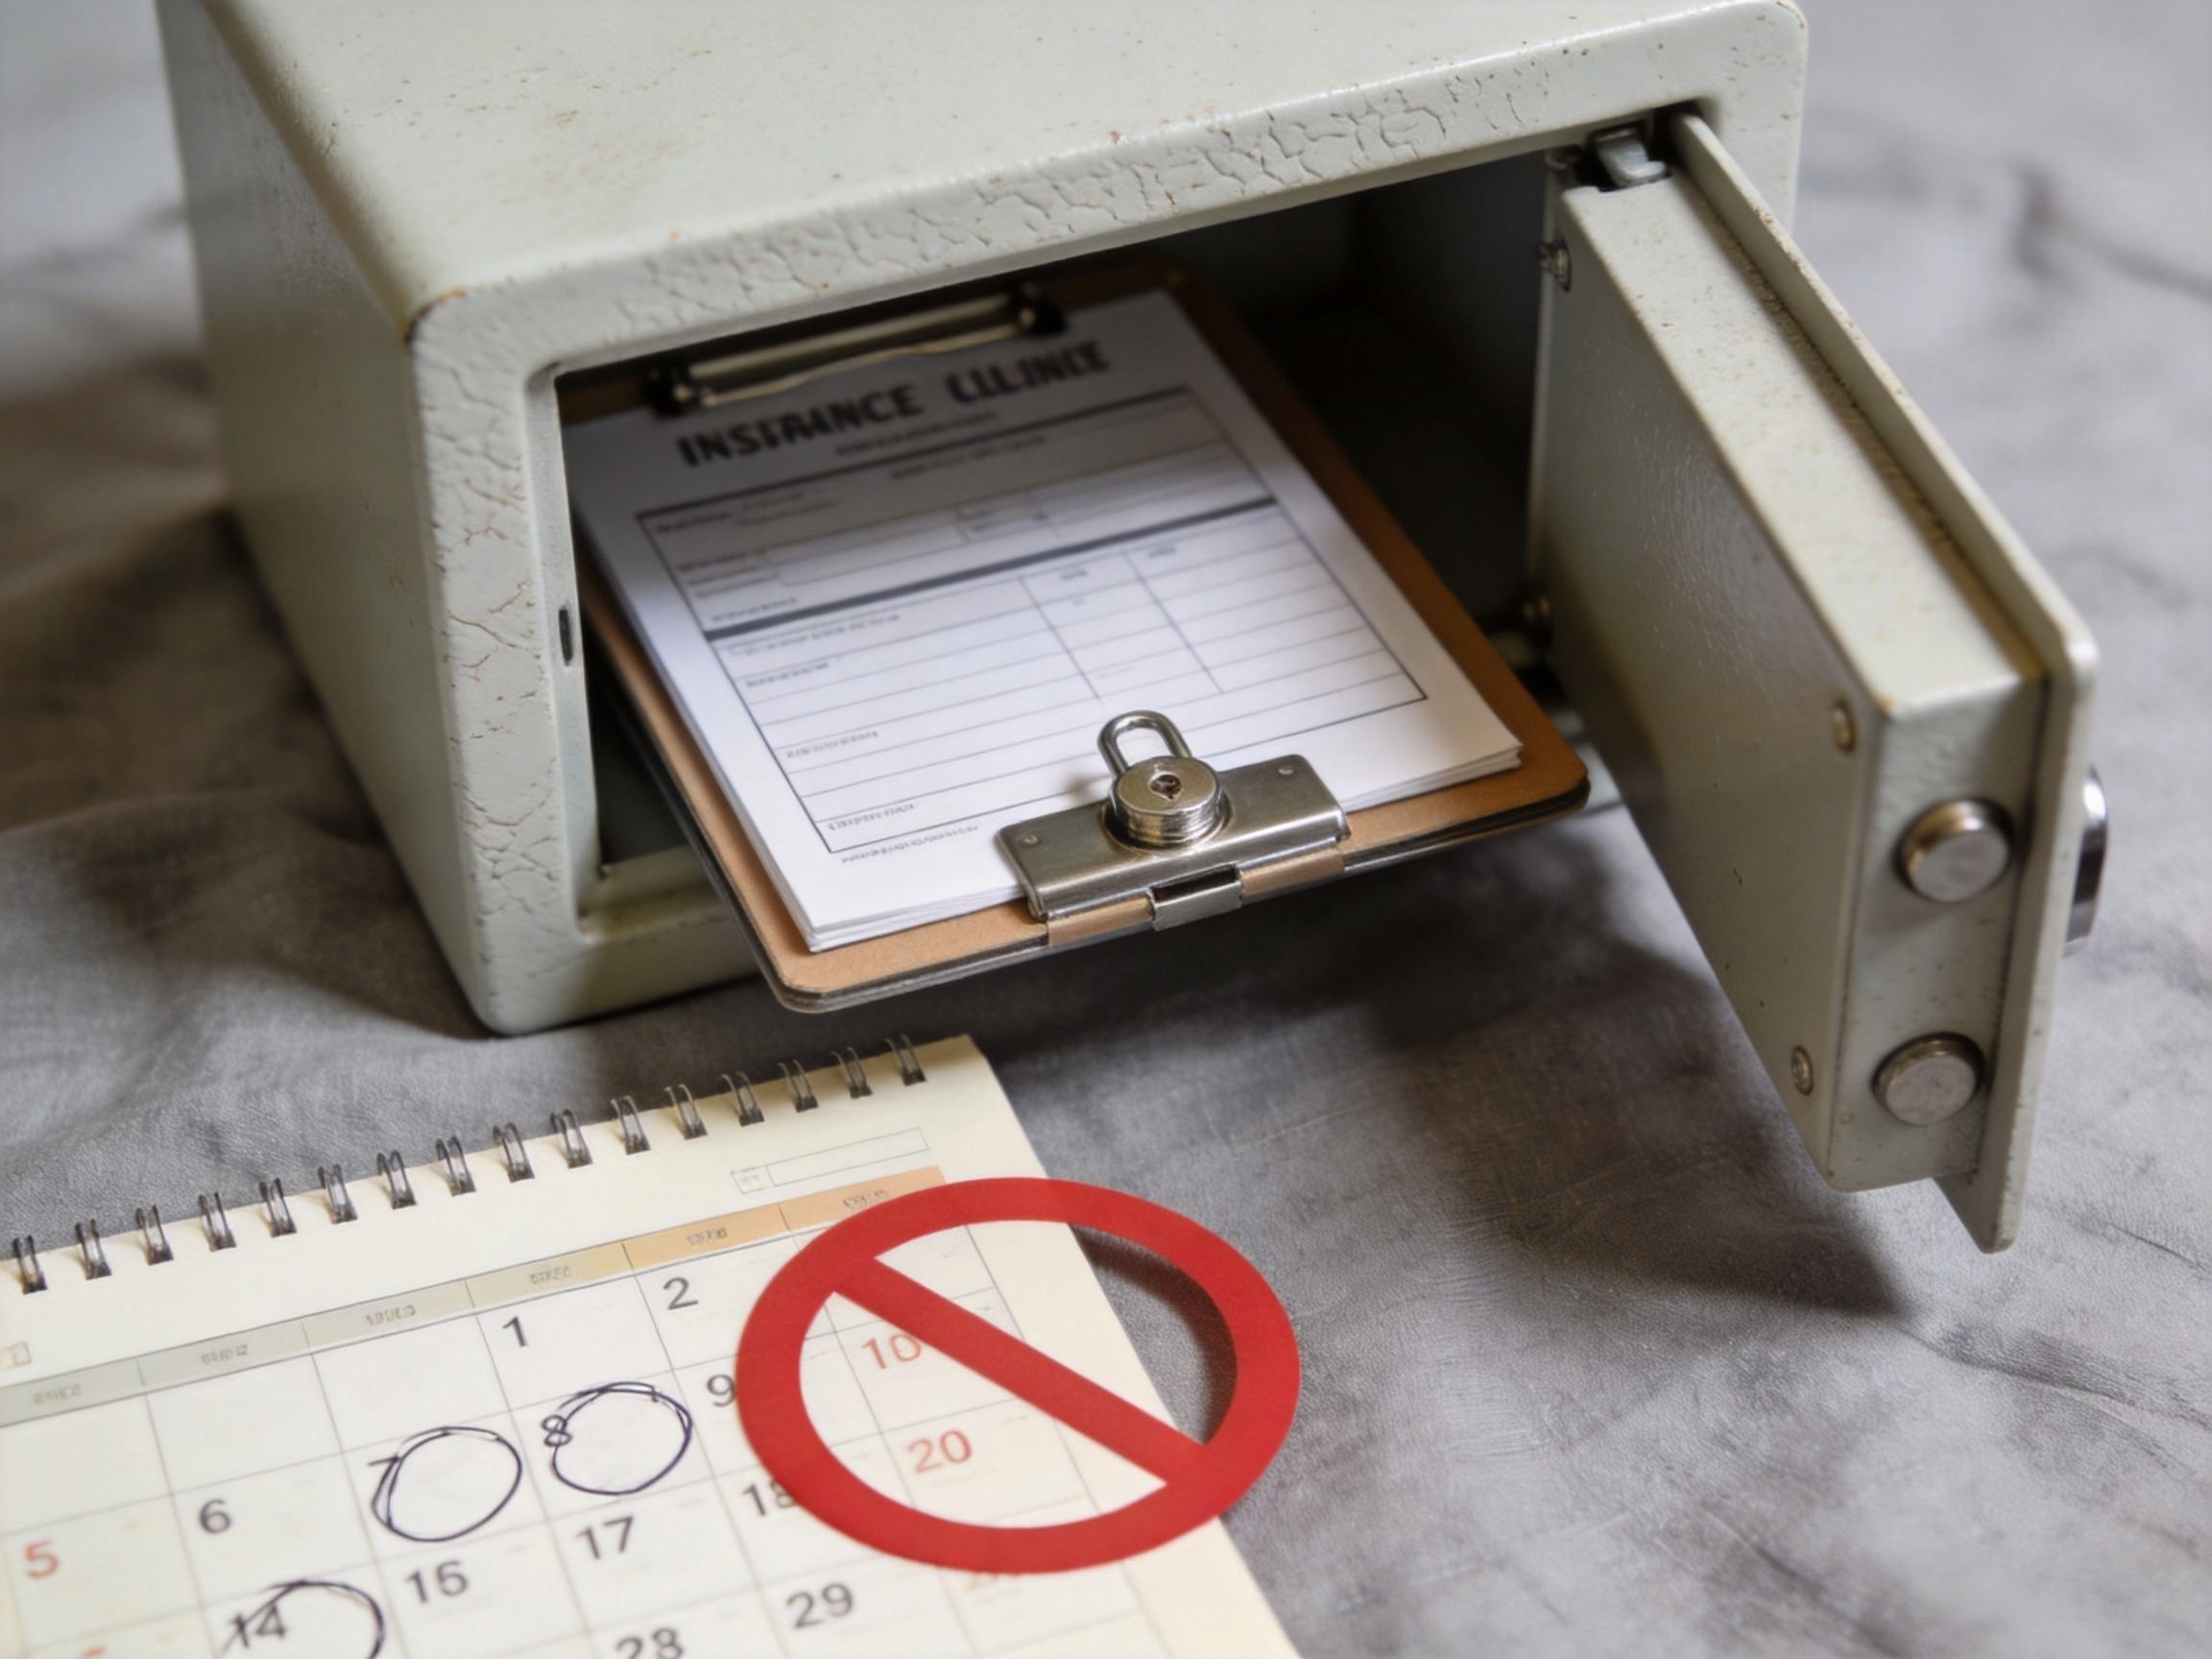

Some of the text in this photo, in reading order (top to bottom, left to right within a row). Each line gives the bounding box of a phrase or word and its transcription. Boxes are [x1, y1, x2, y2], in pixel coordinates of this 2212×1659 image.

[502, 1276, 699, 1348] 1 2
[24, 1542, 60, 1579] 5
[199, 1500, 231, 1534] 6
[541, 1414, 573, 1448] 8
[707, 1374, 737, 1407] 9
[862, 1333, 922, 1369] 10
[406, 1560, 469, 1604] 16
[577, 1514, 635, 1560] 17
[908, 1430, 973, 1474] 20
[615, 1582, 854, 1659] 28 29
